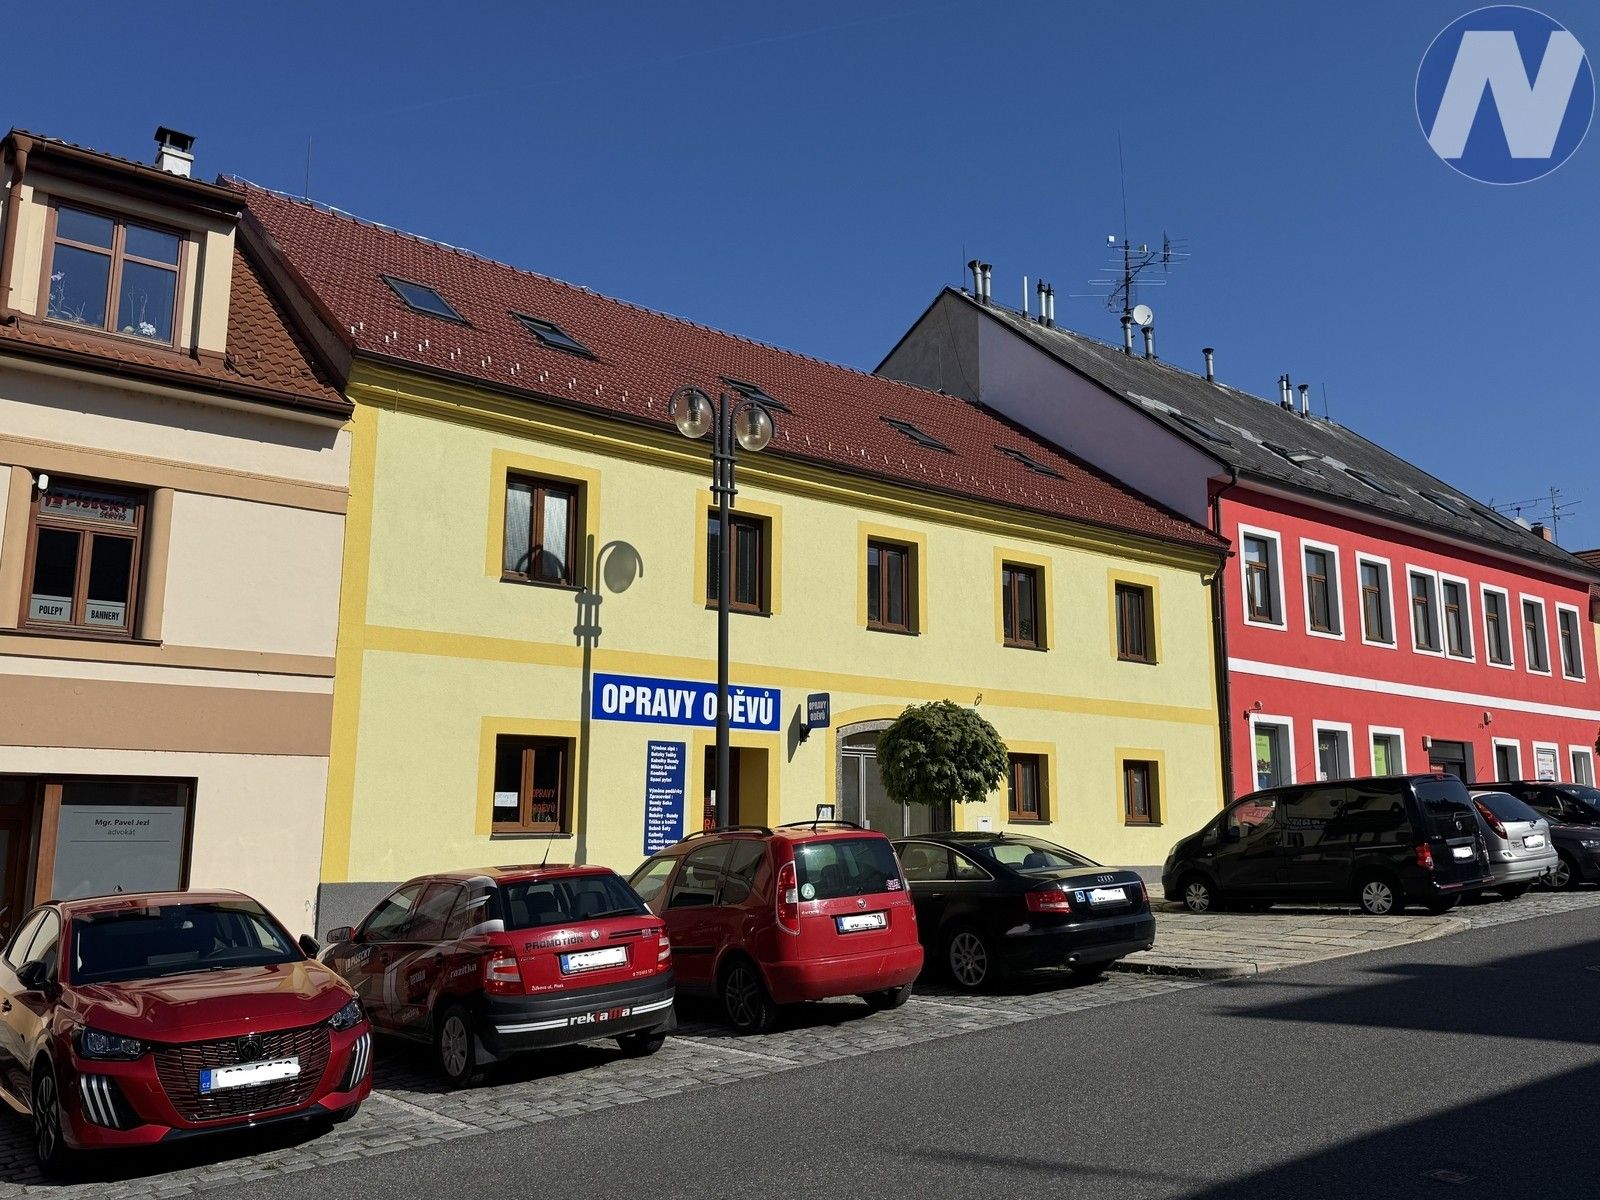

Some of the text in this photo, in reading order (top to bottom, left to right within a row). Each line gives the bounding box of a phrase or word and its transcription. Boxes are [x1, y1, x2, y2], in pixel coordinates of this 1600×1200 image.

[38, 604, 63, 616] POLEPY
[91, 610, 120, 621] BANNERY
[602, 683, 773, 725] OPRAVY OĚVŮ
[95, 819, 112, 827] Mgr.
[525, 936, 584, 950] PROMOTION
[569, 1008, 630, 1026] reklama
